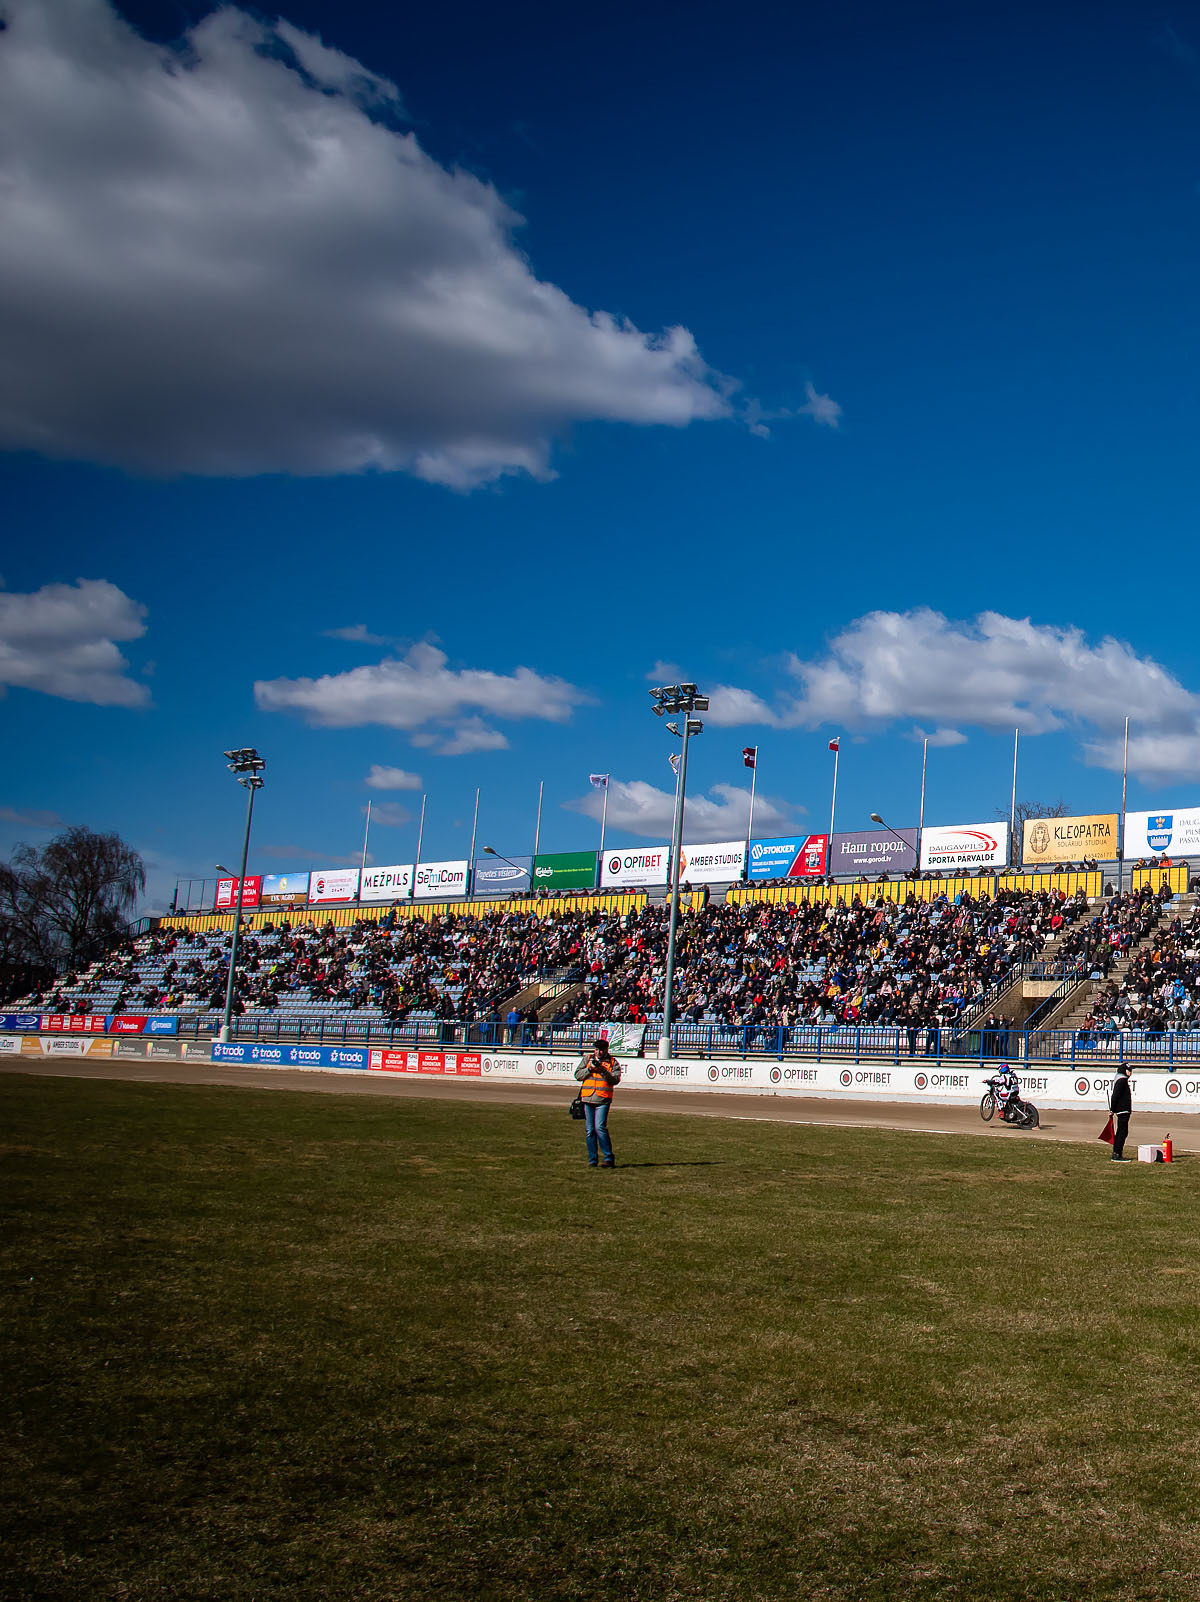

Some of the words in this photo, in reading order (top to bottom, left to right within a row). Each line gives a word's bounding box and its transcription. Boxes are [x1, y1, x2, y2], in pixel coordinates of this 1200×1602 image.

[1054, 824, 1111, 840] KLEOPATRA
[763, 844, 795, 854] STOKKER
[840, 842, 867, 854] Наш
[870, 840, 906, 856] город.
[929, 842, 984, 852] DAUGAVPILS
[624, 854, 662, 868] OPTIBET
[690, 856, 712, 866] AMBER
[714, 854, 742, 864] STUDIOS
[853, 855, 892, 864] www.gorod.lv
[928, 855, 956, 864] SPORTA
[364, 871, 408, 888] MEŽPILS
[417, 870, 463, 884] SemiCom
[222, 1046, 245, 1056] trodo
[260, 1048, 281, 1058] trodo
[298, 1049, 321, 1060] trodo
[339, 1051, 363, 1062] trodo
[493, 1060, 519, 1070] OPTIBET
[546, 1062, 574, 1072] OPTIBET
[659, 1065, 689, 1076] OPTIBET
[722, 1067, 753, 1078] OPTIBET
[784, 1069, 818, 1080] OPTIBET
[855, 1072, 892, 1084] OPTIBET
[930, 1074, 969, 1087] OPTIBET
[1016, 1078, 1048, 1090] PTIBET
[1094, 1079, 1137, 1091] OPTT
